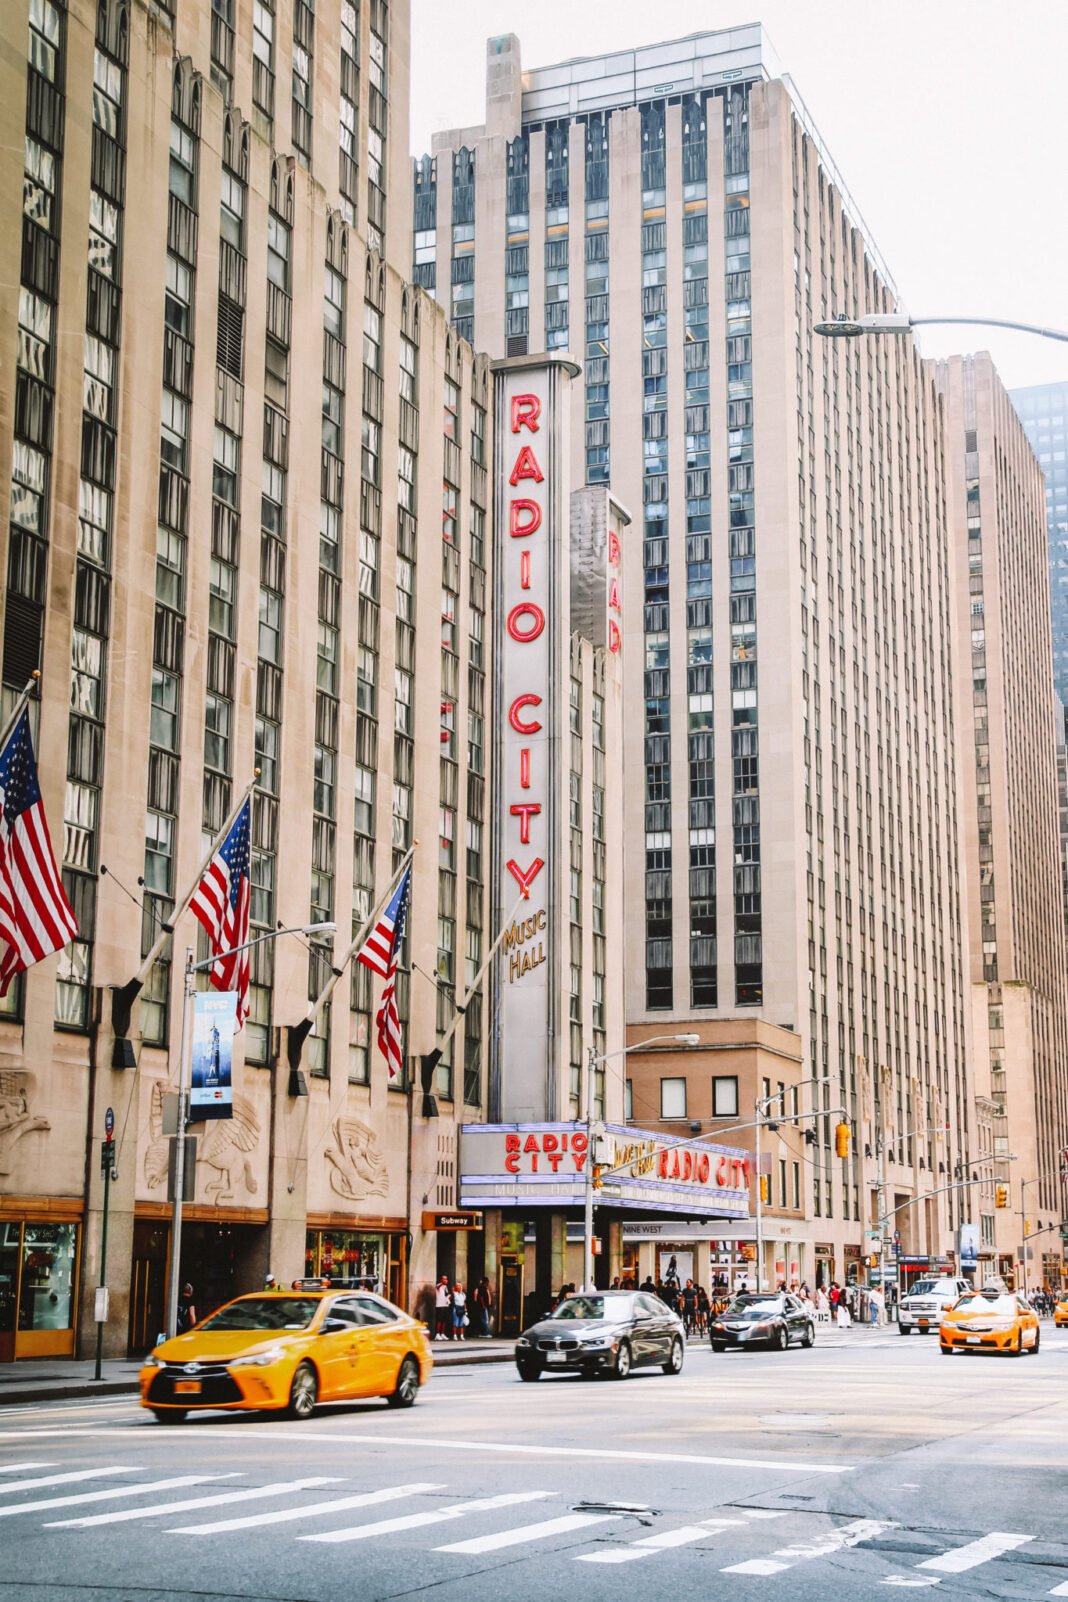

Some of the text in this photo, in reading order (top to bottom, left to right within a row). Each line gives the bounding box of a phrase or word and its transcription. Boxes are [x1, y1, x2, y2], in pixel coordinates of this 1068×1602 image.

[507, 394, 545, 900] RADIO CITY
[503, 909, 546, 954] MUSIC
[509, 942, 546, 983] HALL
[505, 1132, 589, 1154] RADIO
[505, 1153, 587, 1174] CITY
[657, 1145, 751, 1191] RADIO CITY
[440, 1217, 468, 1226] Subway
[623, 1225, 663, 1233] NINE WEST
